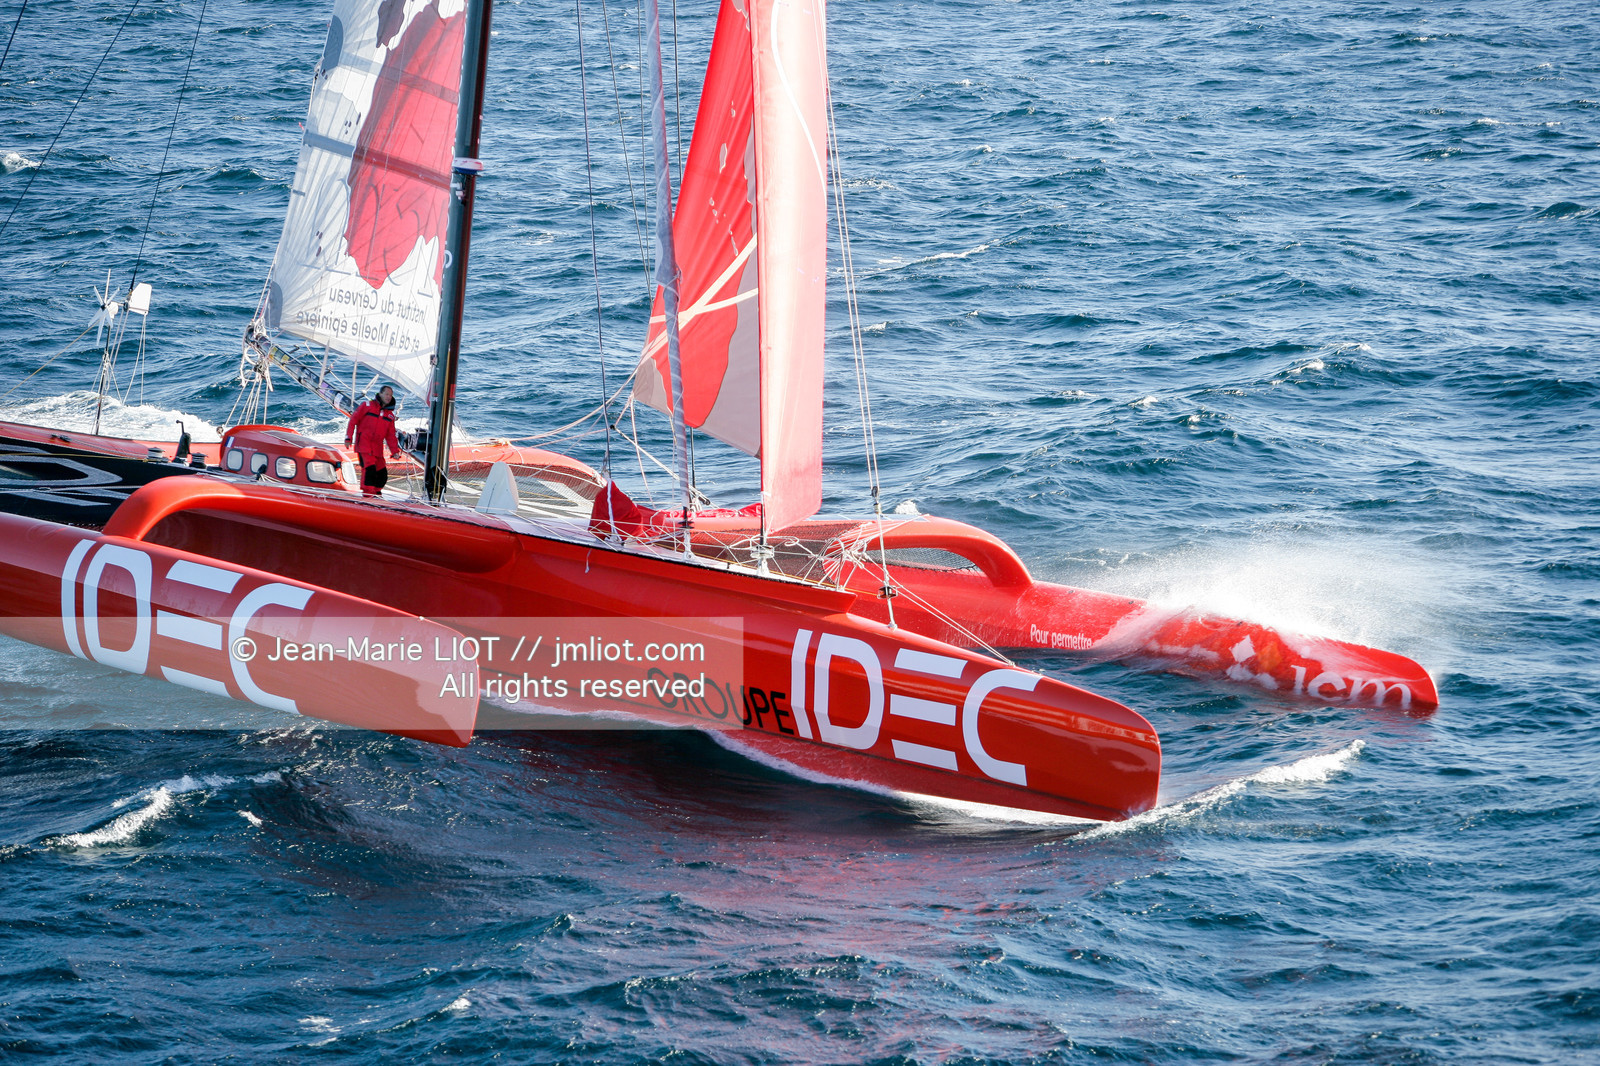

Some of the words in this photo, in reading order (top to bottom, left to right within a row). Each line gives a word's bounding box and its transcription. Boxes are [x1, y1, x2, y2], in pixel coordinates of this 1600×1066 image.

[61, 538, 315, 715] IDEC
[1030, 623, 1049, 645] Pour
[1051, 631, 1092, 650] permettre
[1290, 645, 1412, 710] icm
[647, 667, 795, 735] GROUPE
[791, 628, 1043, 787] IDEC
